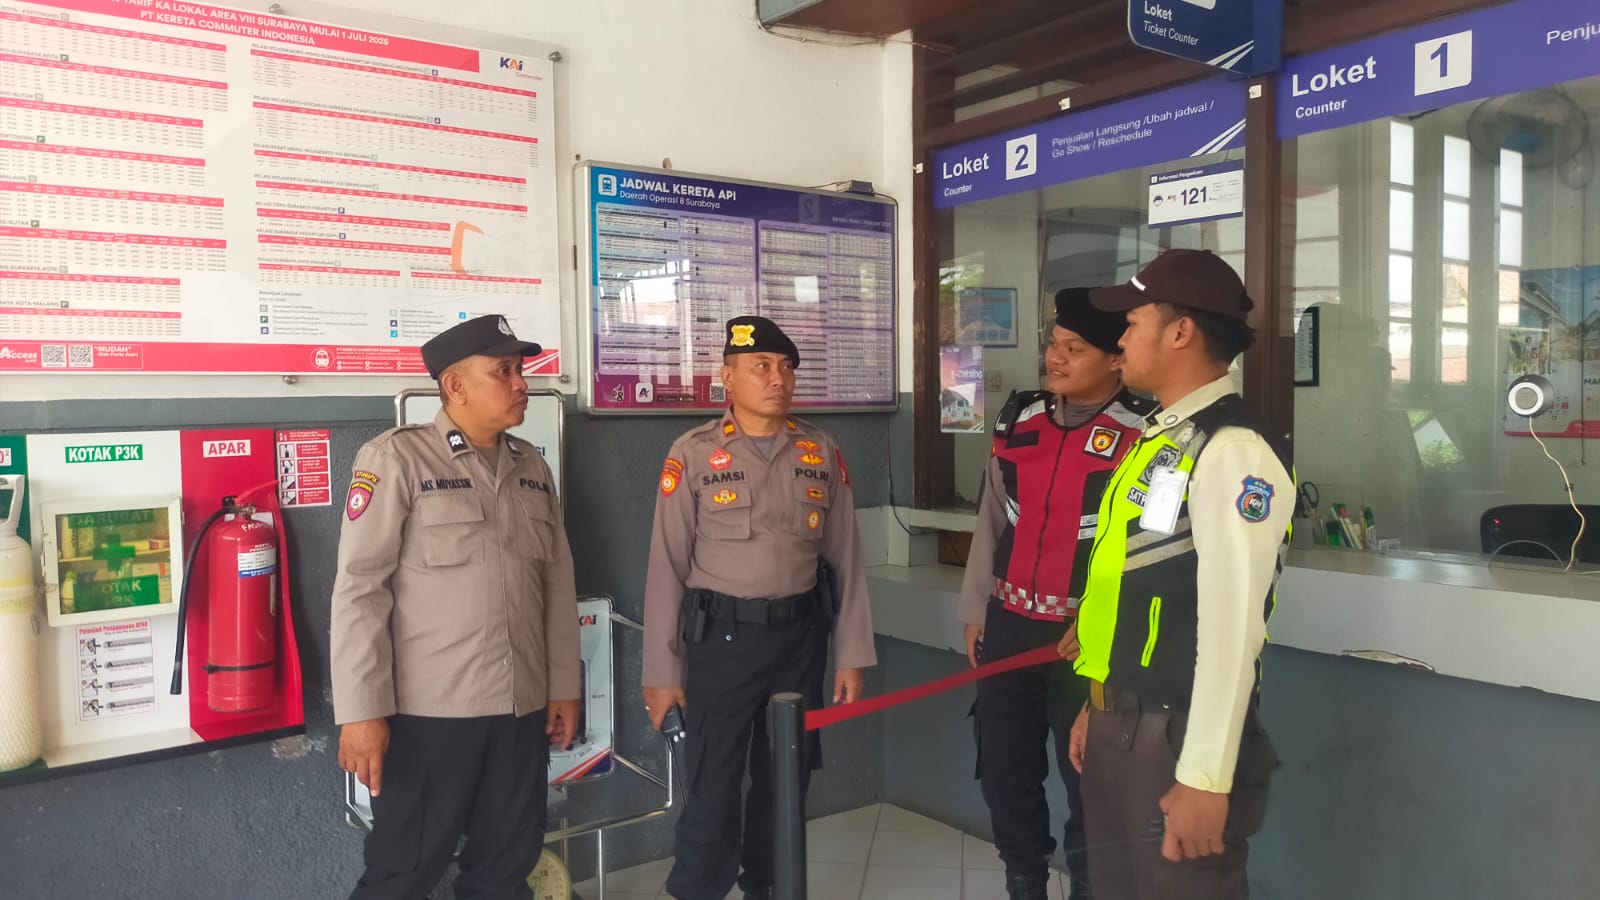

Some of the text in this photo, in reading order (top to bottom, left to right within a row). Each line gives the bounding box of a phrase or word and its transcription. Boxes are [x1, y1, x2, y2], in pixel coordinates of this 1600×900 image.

[1143, 1, 1173, 21] Loket
[141, 10, 315, 45] PT KERETA COMMUTER INDONESIA
[155, 1, 170, 10] KA
[173, 3, 207, 16] LOKAL
[210, 9, 237, 20] AREA
[239, 13, 255, 24] VIII
[257, 17, 308, 32] SURABAYA
[309, 26, 340, 37] MULAI
[347, 32, 367, 41] JULI
[368, 36, 390, 46] 2025
[1143, 20, 1199, 46] Ticket Counter
[1292, 41, 1448, 97] Loket 1
[1295, 99, 1348, 119] Counter
[1052, 130, 1094, 147] Penjualan
[1096, 118, 1141, 138] Langsung
[1174, 102, 1208, 121] jadwal
[1052, 148, 1065, 158] Go
[1066, 142, 1090, 155] Show
[1098, 128, 1153, 147] Reschedule
[943, 144, 1029, 179] Loket 2
[620, 177, 737, 201] JADWAL KERETA API
[943, 184, 973, 197] Counter
[1180, 185, 1207, 206] 121
[620, 190, 648, 201] Daerah
[649, 194, 679, 205] Operasi
[686, 199, 721, 210] Surabaya
[68, 445, 140, 462] KOTAK P3K
[208, 441, 246, 456] APAR
[702, 470, 745, 486] SAMSI
[795, 467, 829, 481] POLRI
